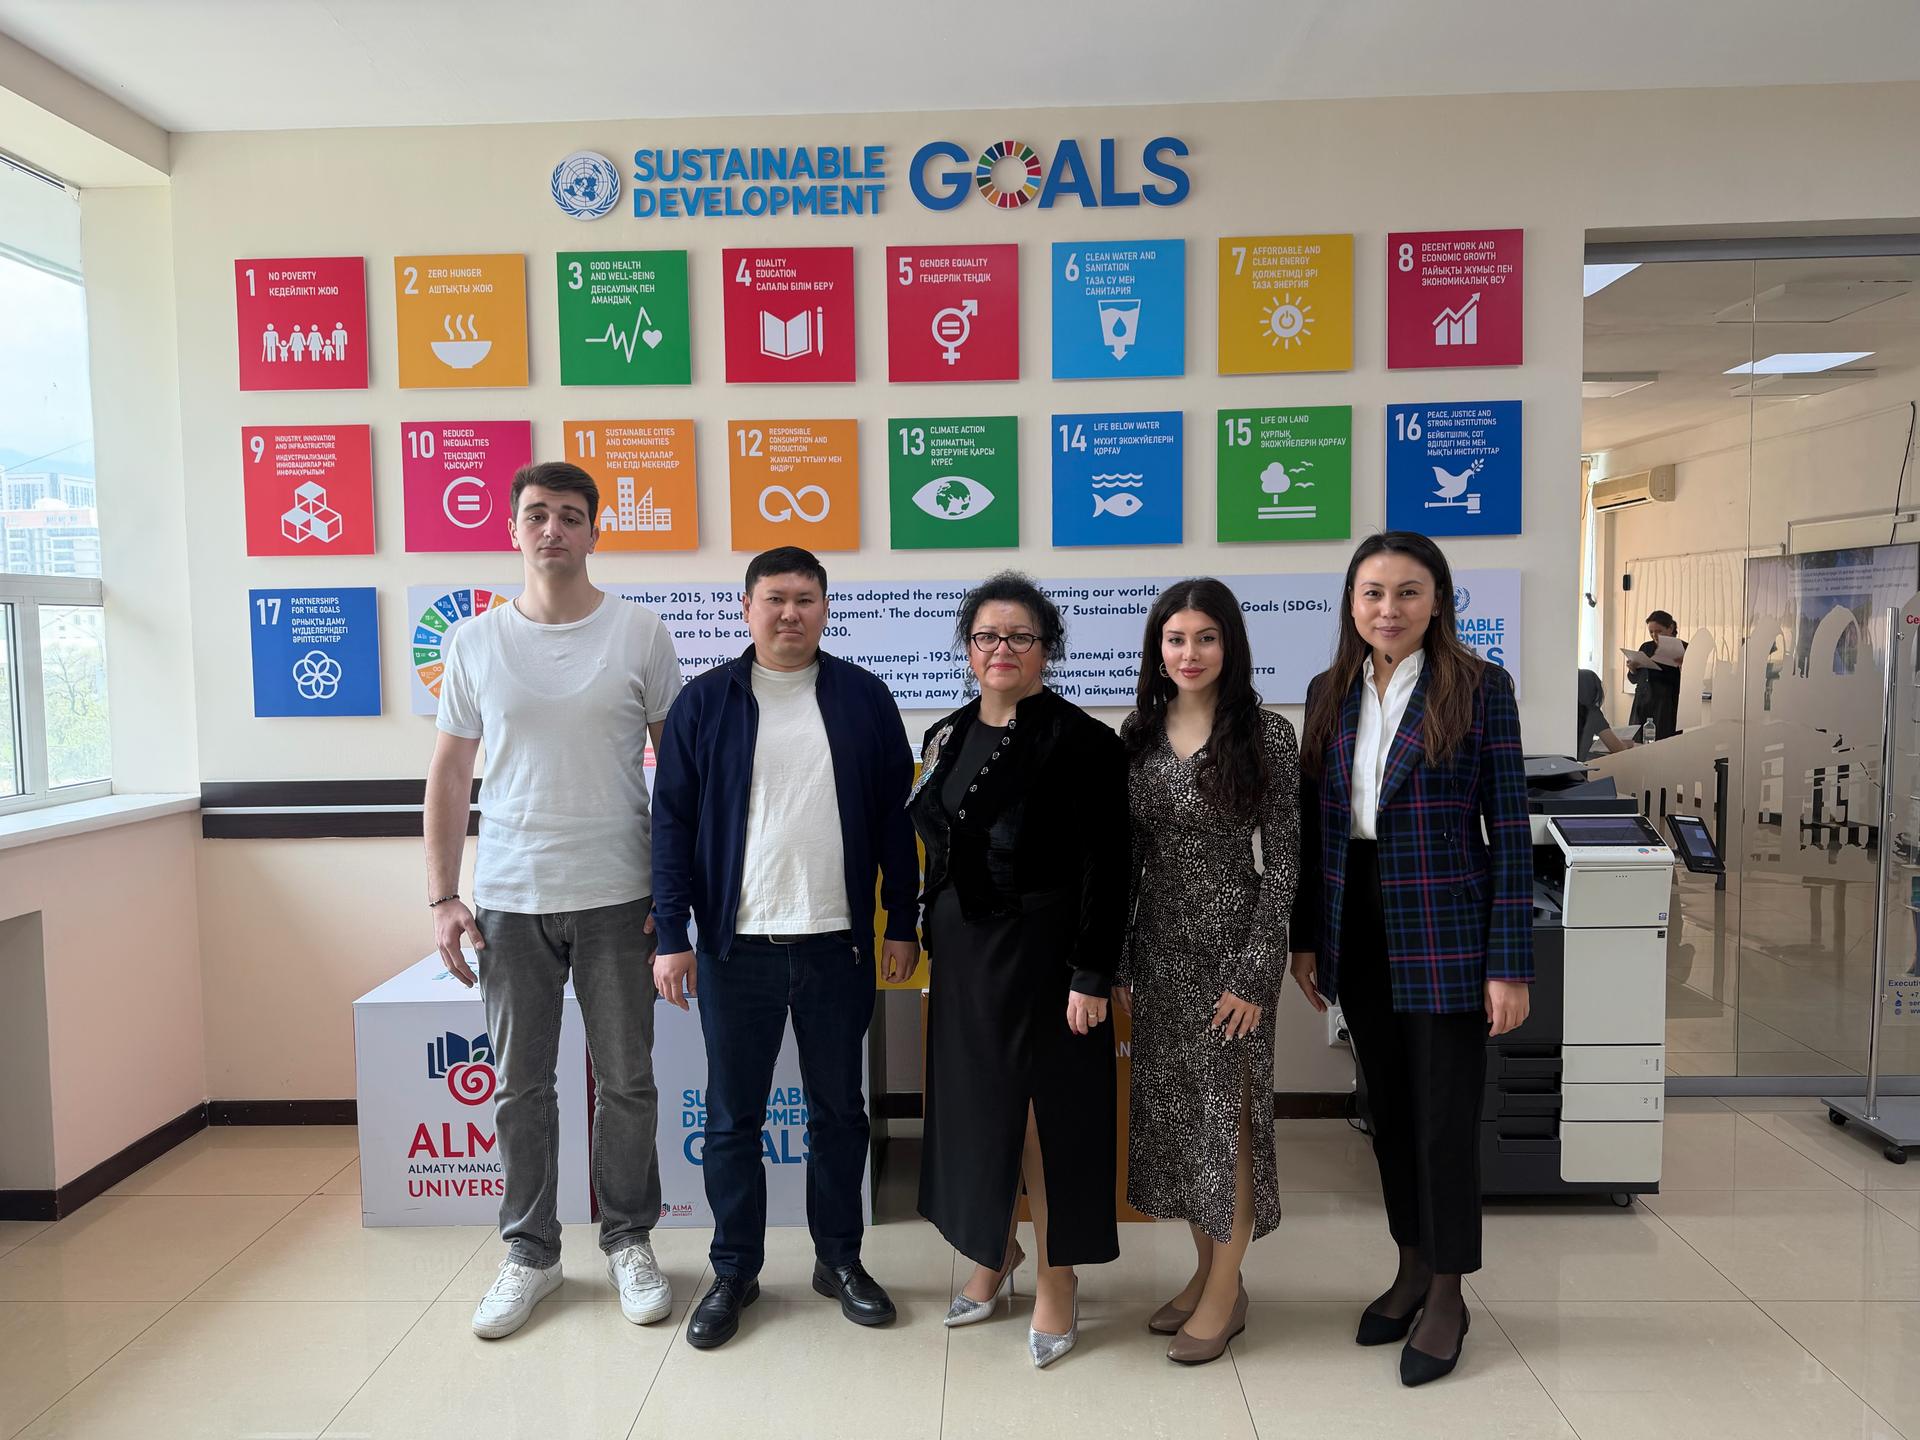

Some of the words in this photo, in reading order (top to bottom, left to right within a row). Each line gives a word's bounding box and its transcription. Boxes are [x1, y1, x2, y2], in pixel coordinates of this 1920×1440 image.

[633, 146, 885, 182] SUSTAINABLE
[910, 136, 1190, 211] GOALS
[633, 184, 885, 218] DEVELOPMENT
[1253, 246, 1302, 256] AFFORDABLE
[1304, 246, 1320, 254] AND
[1422, 242, 1451, 252] DECENT
[1454, 242, 1476, 251] WORK
[1478, 241, 1494, 250] AND
[1086, 253, 1110, 262] CLEAN
[1112, 252, 1137, 261] WATER
[1140, 251, 1156, 260] AND
[1232, 248, 1246, 275] 7
[1253, 258, 1278, 266] CLEAN
[1280, 257, 1309, 265] ENERGY
[1398, 243, 1414, 272] 8
[1422, 253, 1461, 262] ECONOMIC
[1464, 252, 1496, 261] GROWTH
[590, 261, 609, 270] GOOD
[612, 261, 641, 269] HEALTH
[756, 259, 786, 268] QUALITY
[920, 259, 950, 268] GENDER
[952, 258, 987, 268] EQUALITY
[1065, 253, 1079, 281] 6
[1086, 263, 1129, 272] SANITATION
[428, 269, 447, 278] ZERO
[450, 268, 482, 278] HUNGER
[736, 258, 752, 286] 4
[756, 269, 796, 278] EDUCATION
[899, 257, 913, 285] 5
[1253, 270, 1303, 280] ҚОЛЖЕТІМДІ
[1305, 269, 1318, 278] ӘРІ
[1422, 267, 1462, 276] ЛАЙЫҚТЫ
[1498, 264, 1512, 273] ПЕН
[269, 272, 280, 281] NO
[282, 271, 316, 280] POVERTY
[568, 262, 582, 289] 3
[591, 272, 606, 280] AND
[609, 272, 655, 280] WELL-BEING
[920, 274, 961, 283] ГЕНДЕРЛІК
[963, 273, 991, 282] ТЕҢДІК
[1085, 277, 1104, 285] ТАЗА
[1106, 276, 1117, 285] СУ
[1119, 276, 1135, 284] МЕН
[1422, 275, 1489, 286] ЭКОНОМИКАЛЫҚ
[1491, 275, 1505, 284] ӨСУ
[246, 269, 255, 296] 1
[403, 267, 418, 295] 2
[756, 282, 788, 291] САПАЛЫ
[790, 282, 812, 290] БІЛІМ
[814, 281, 833, 291] БЕРУ
[1252, 281, 1271, 289] ТАЗА
[1274, 280, 1308, 289] ЭНЕРГИЯ
[269, 287, 316, 297] КЕДЕЙЛІКТІ
[318, 287, 338, 296] ЖОЮ
[429, 285, 470, 296] АШТЫҚТЫ
[472, 284, 493, 293] ЖОЮ
[591, 285, 637, 294] ДЕНСАУЛЫҚ
[640, 284, 655, 293] ПЕН
[1086, 286, 1131, 296] САНИТАРИЯ
[591, 295, 631, 304] АМАНДЫҚ
[1261, 416, 1276, 424] LIFE
[1290, 415, 1309, 424] LAND
[1428, 419, 1453, 427] STRONG
[930, 426, 959, 434] CLIMATE
[961, 425, 985, 434] ACTION
[1094, 423, 1109, 431] LIFE
[1111, 422, 1134, 430] BELOW
[1136, 421, 1159, 430] WATER
[1395, 413, 1421, 441] 16
[443, 430, 474, 438] REDUCED
[606, 428, 651, 437] SUSTAINABLE
[653, 428, 675, 436] CITIES
[1225, 418, 1251, 446] 15
[443, 438, 489, 447] INEQUALITIES
[623, 438, 669, 446] COMMUNITIES
[737, 430, 763, 457] 12
[900, 428, 924, 456] 13
[931, 438, 975, 447] КЛИМАТТЫҢ
[1059, 425, 1087, 452] 14
[1119, 435, 1174, 444] ЭКОЖҮЙЕЛЕРІН
[1261, 438, 1317, 448] ЭКОЖҮЙЕЛЕРІН
[1319, 437, 1346, 447] ҚОРҒАУ
[408, 431, 434, 459] 10
[576, 430, 595, 458] 11
[250, 436, 265, 463] 9
[931, 448, 969, 456] ӨЗГЕРУІНЕ
[971, 447, 995, 457] ҚАРСЫ
[1427, 448, 1452, 456] МЫҚТЫ
[1454, 447, 1499, 455] ИНСТИТУТТАР
[444, 452, 486, 461] ТЕҢСІЗДІКТІ
[640, 451, 673, 460] ҚАЛАЛАР
[444, 461, 483, 470] ҚЫСҚАРТУ
[607, 461, 621, 469] МЕН
[623, 460, 640, 469] ЕЛДІ
[642, 460, 679, 469] МЕКЕНДЕР
[770, 464, 794, 473] ӨНДІРУ
[671, 592, 705, 604] 2015,
[712, 592, 732, 602] 193
[857, 590, 909, 603] adopted
[913, 589, 932, 600] the
[1118, 585, 1159, 596] world:
[291, 597, 339, 605] PARTNERSHIPS
[256, 599, 280, 626] 17
[320, 606, 340, 614] GOALS
[696, 610, 714, 620] for
[889, 608, 910, 618] The
[1073, 604, 1147, 615] Sustainable
[1241, 601, 1279, 611] Goals
[1283, 600, 1331, 613] (SDGs),
[292, 618, 325, 627] ОРНЫҚТЫ
[326, 618, 345, 626] ДАМУ
[675, 630, 695, 638] are
[699, 629, 711, 638] to
[715, 628, 730, 637] be
[293, 635, 340, 643] ӘРІПТЕСТІКТЕР
[858, 652, 919, 665] мүшелері
[1070, 649, 1113, 660] әлемді
[897, 671, 918, 682] күн
[926, 690, 958, 700] даму
[408, 1164, 454, 1173] ALMATY
